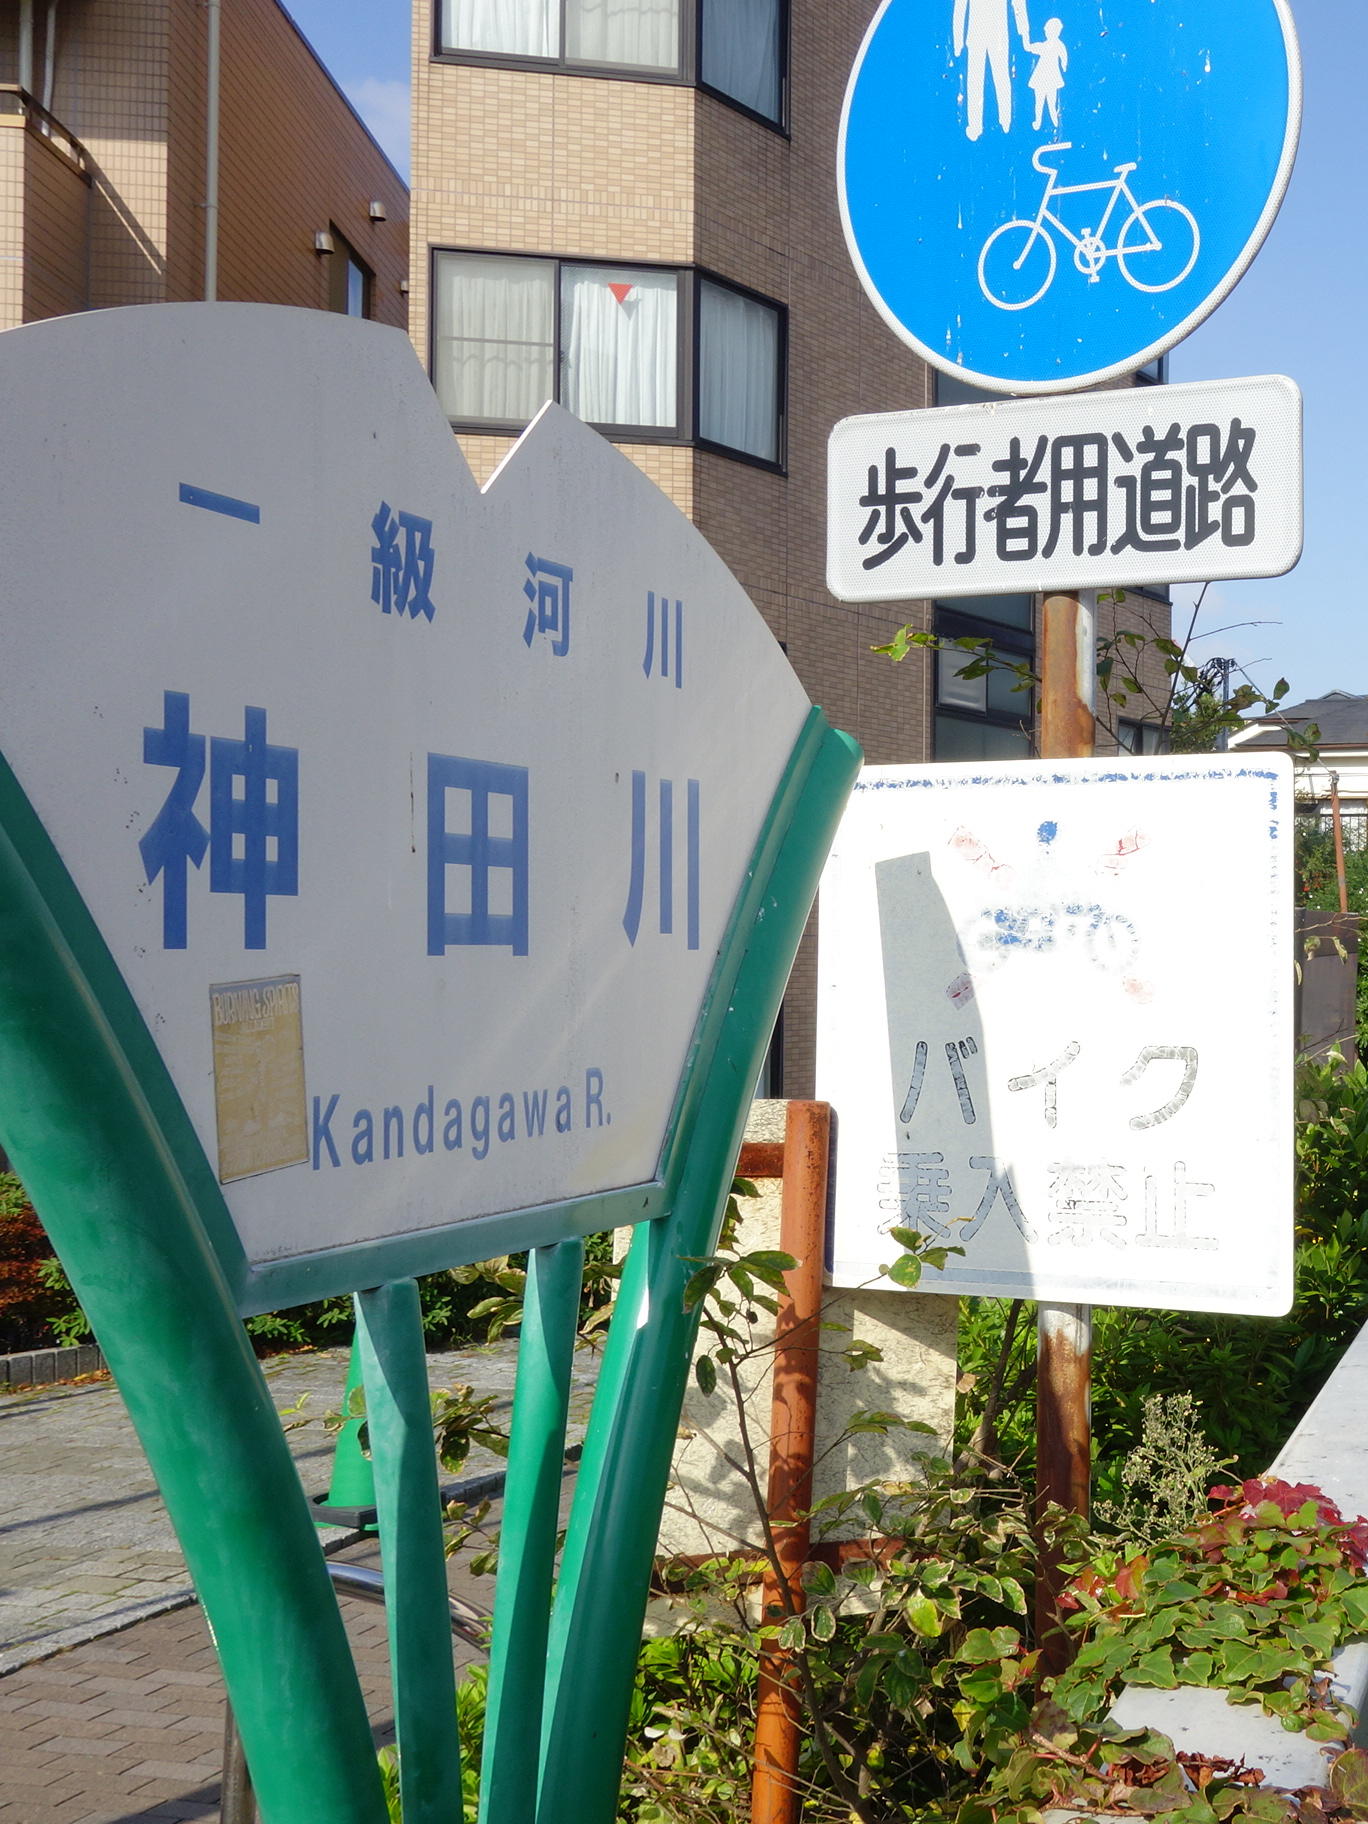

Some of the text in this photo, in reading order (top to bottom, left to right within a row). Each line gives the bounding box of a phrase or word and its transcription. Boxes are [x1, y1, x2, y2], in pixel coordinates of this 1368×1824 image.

[858, 417, 1258, 571] 歩行者用道路
[178, 482, 684, 690] 一級河川
[138, 690, 700, 957] 神田川
[312, 1085, 571, 1171] Kandagawa
[585, 1067, 611, 1129] R.
[899, 1035, 1198, 1130] バイク
[876, 1151, 1219, 1250] 乗入禁止
